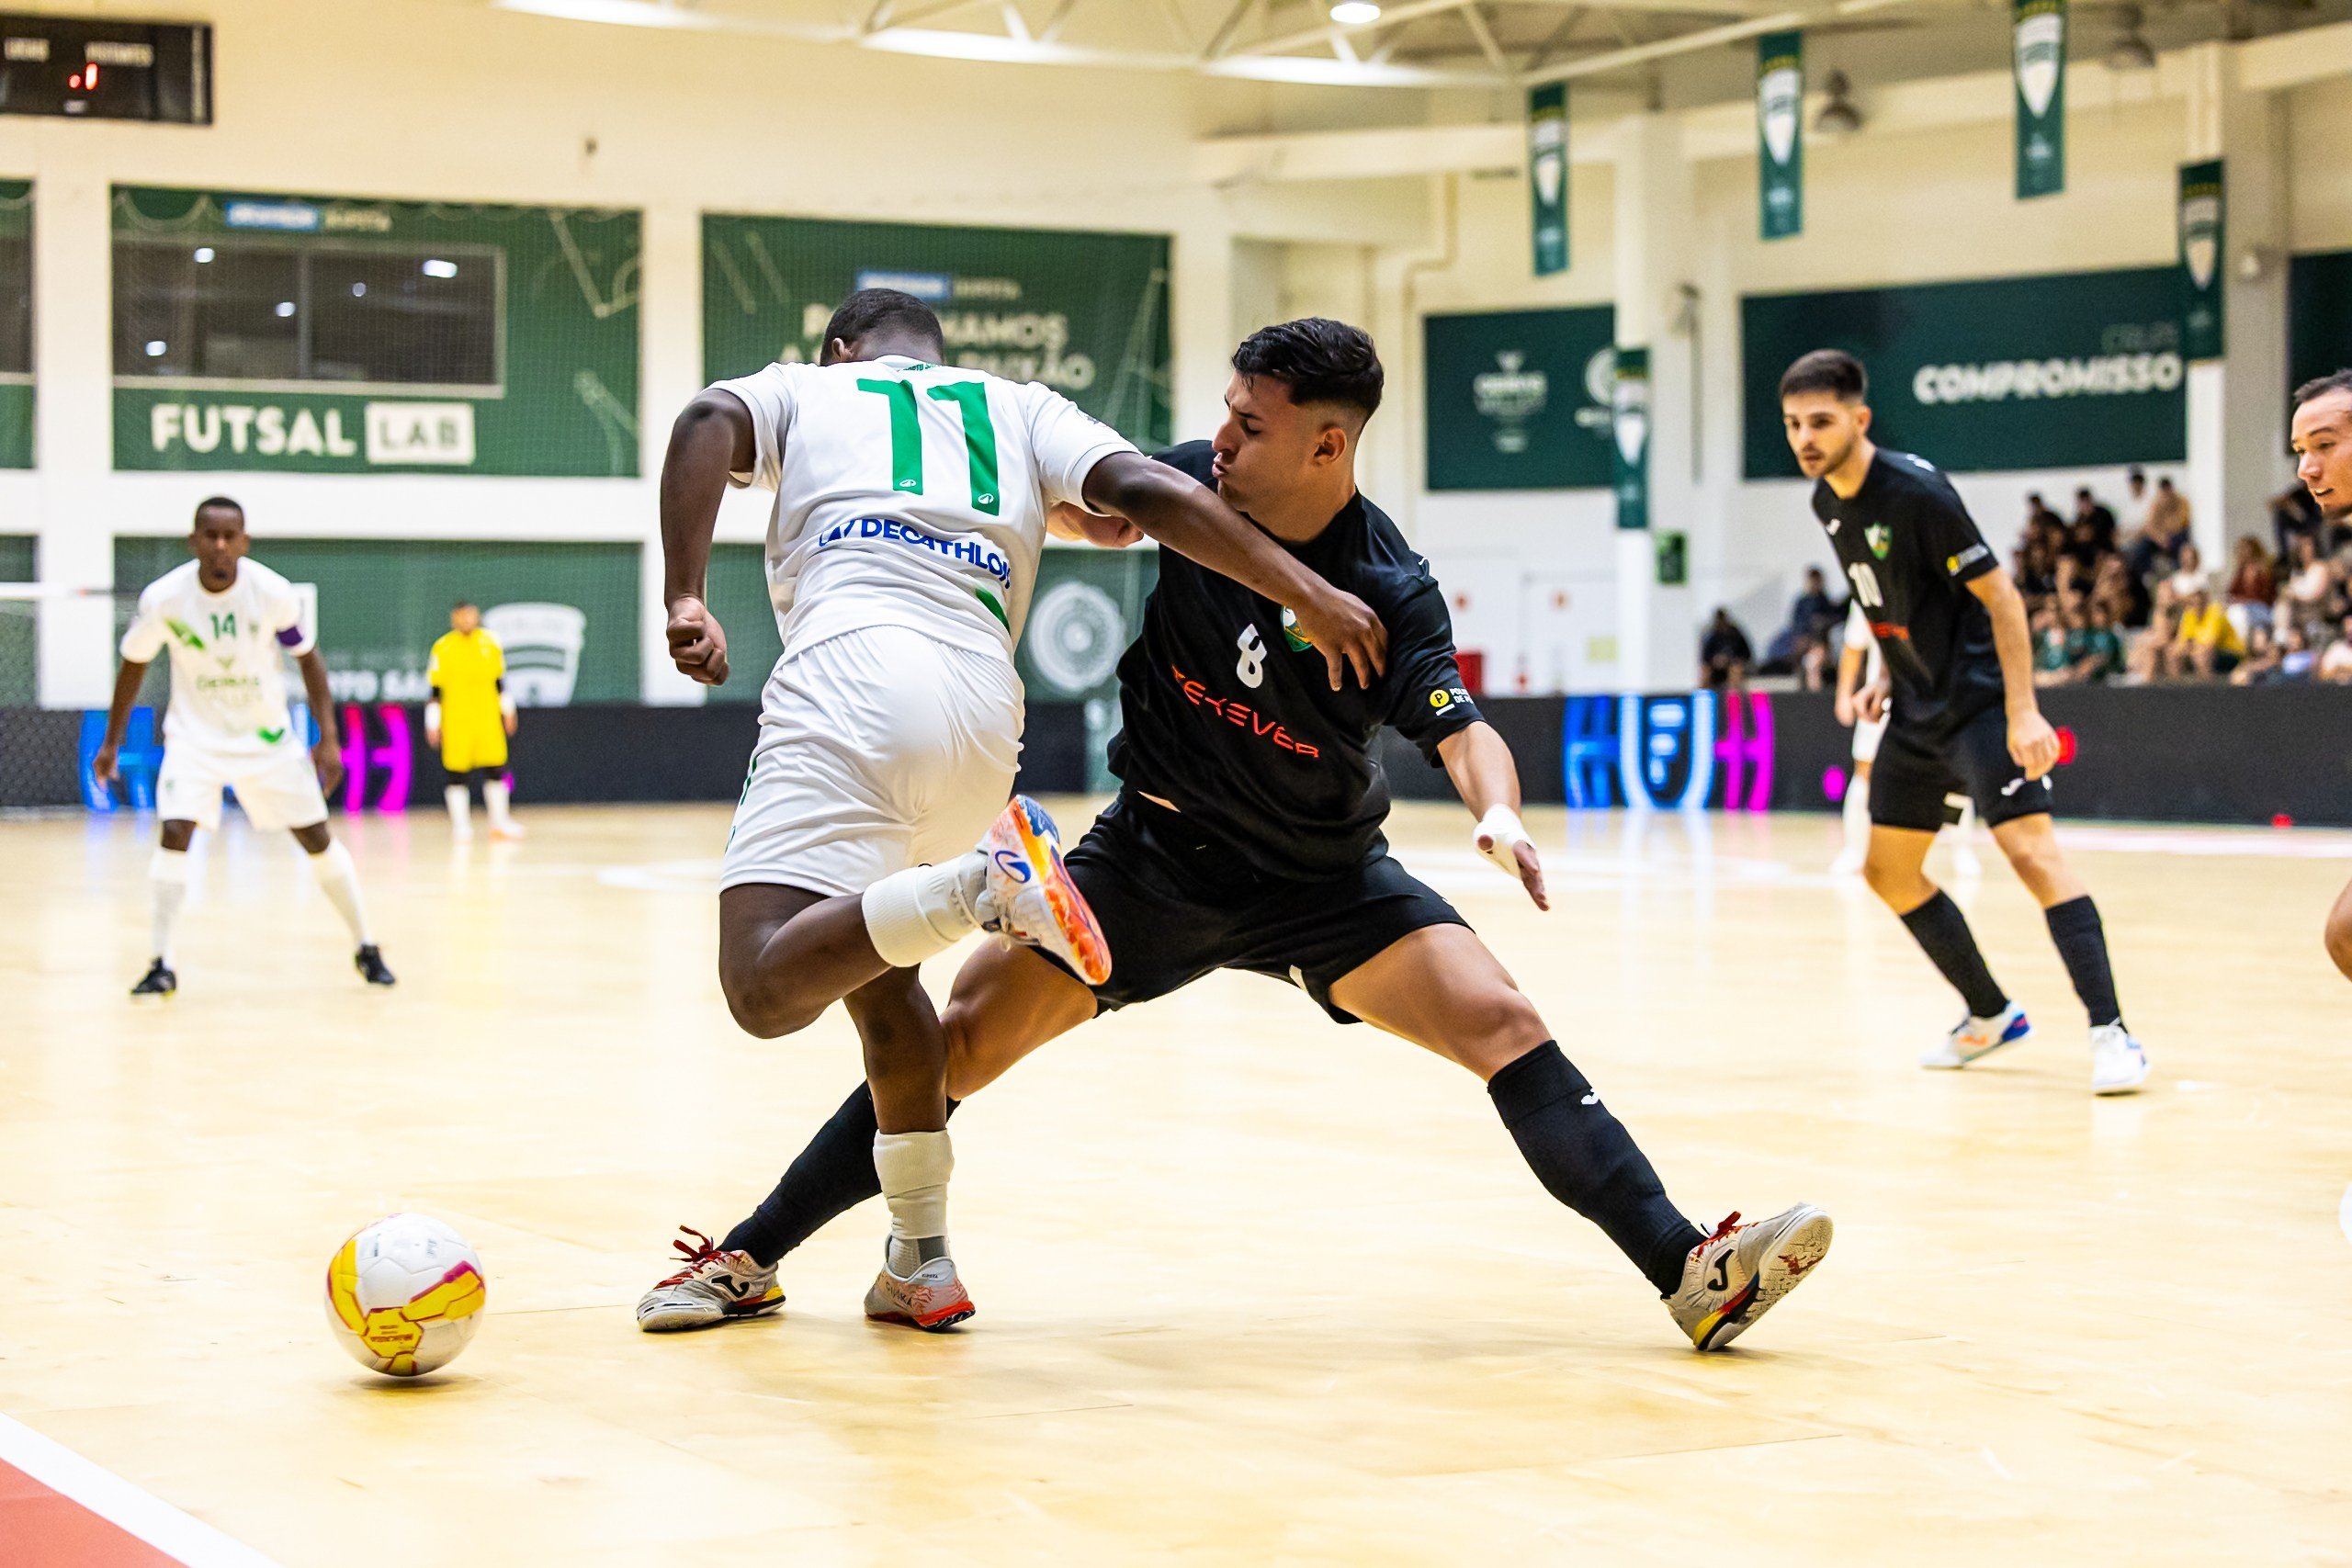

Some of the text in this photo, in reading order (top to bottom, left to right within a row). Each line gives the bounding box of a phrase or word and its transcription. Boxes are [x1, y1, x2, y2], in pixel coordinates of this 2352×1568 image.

[1913, 353, 2183, 404] COMPROMISSO
[152, 403, 460, 457] FUTSAL LAB
[856, 378, 1001, 516] 11
[210, 612, 236, 639] 14
[1237, 624, 1267, 689] 8
